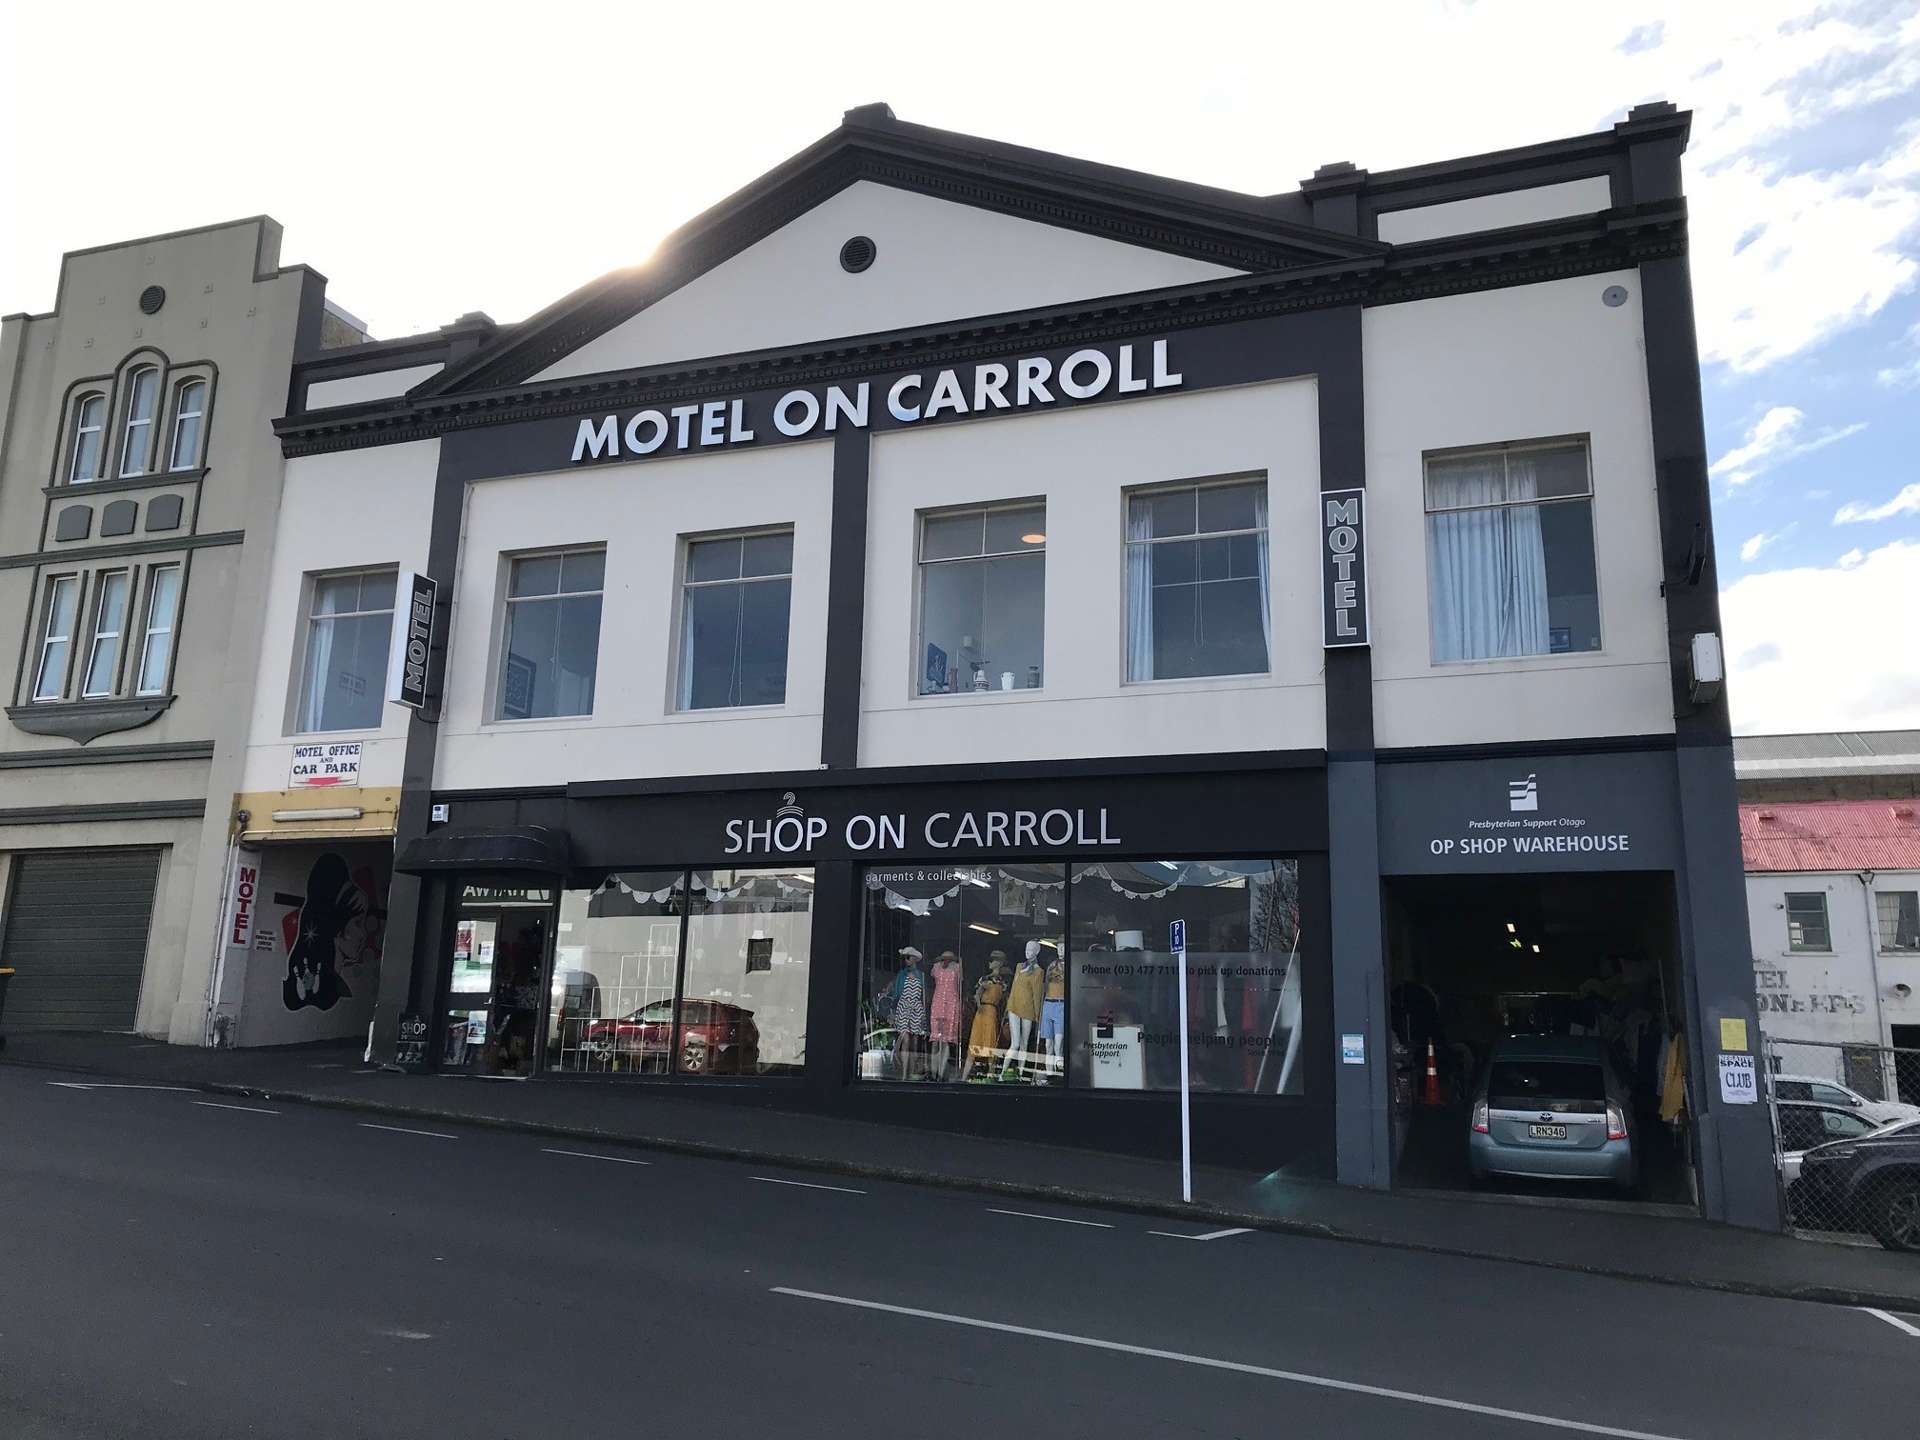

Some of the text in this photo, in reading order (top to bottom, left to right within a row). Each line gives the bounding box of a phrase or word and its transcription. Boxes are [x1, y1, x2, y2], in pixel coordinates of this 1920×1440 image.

[571, 340, 1184, 462] MOTEL ON CARROLL
[1327, 498, 1359, 637] MOTEL
[405, 589, 433, 692] MOTEL
[295, 744, 360, 758] MOTEL OFFICE
[293, 762, 357, 775] CAR PARK
[1469, 818, 1586, 829] Presbyterian Support Otago
[724, 808, 1121, 854] SHOP ON CARROLL
[1430, 835, 1630, 855] OP SHOP WAREHOUSE
[865, 871, 914, 882] garments
[917, 871, 925, 881] &
[233, 867, 257, 945] MOTEL
[1174, 922, 1180, 935] P
[1082, 964, 1111, 975] Phone
[1113, 965, 1134, 976] (03)
[1137, 965, 1154, 976] 477
[1198, 965, 1217, 979] pick
[1221, 968, 1233, 979] up
[1236, 965, 1286, 977] donations
[401, 1022, 427, 1036] SHOP
[1083, 1040, 1128, 1051] Presbyterian
[1090, 1049, 1120, 1058] Support
[1720, 1060, 1754, 1069] SPACE
[1725, 1071, 1752, 1088] CLUB
[1530, 1124, 1565, 1137] LRN346
